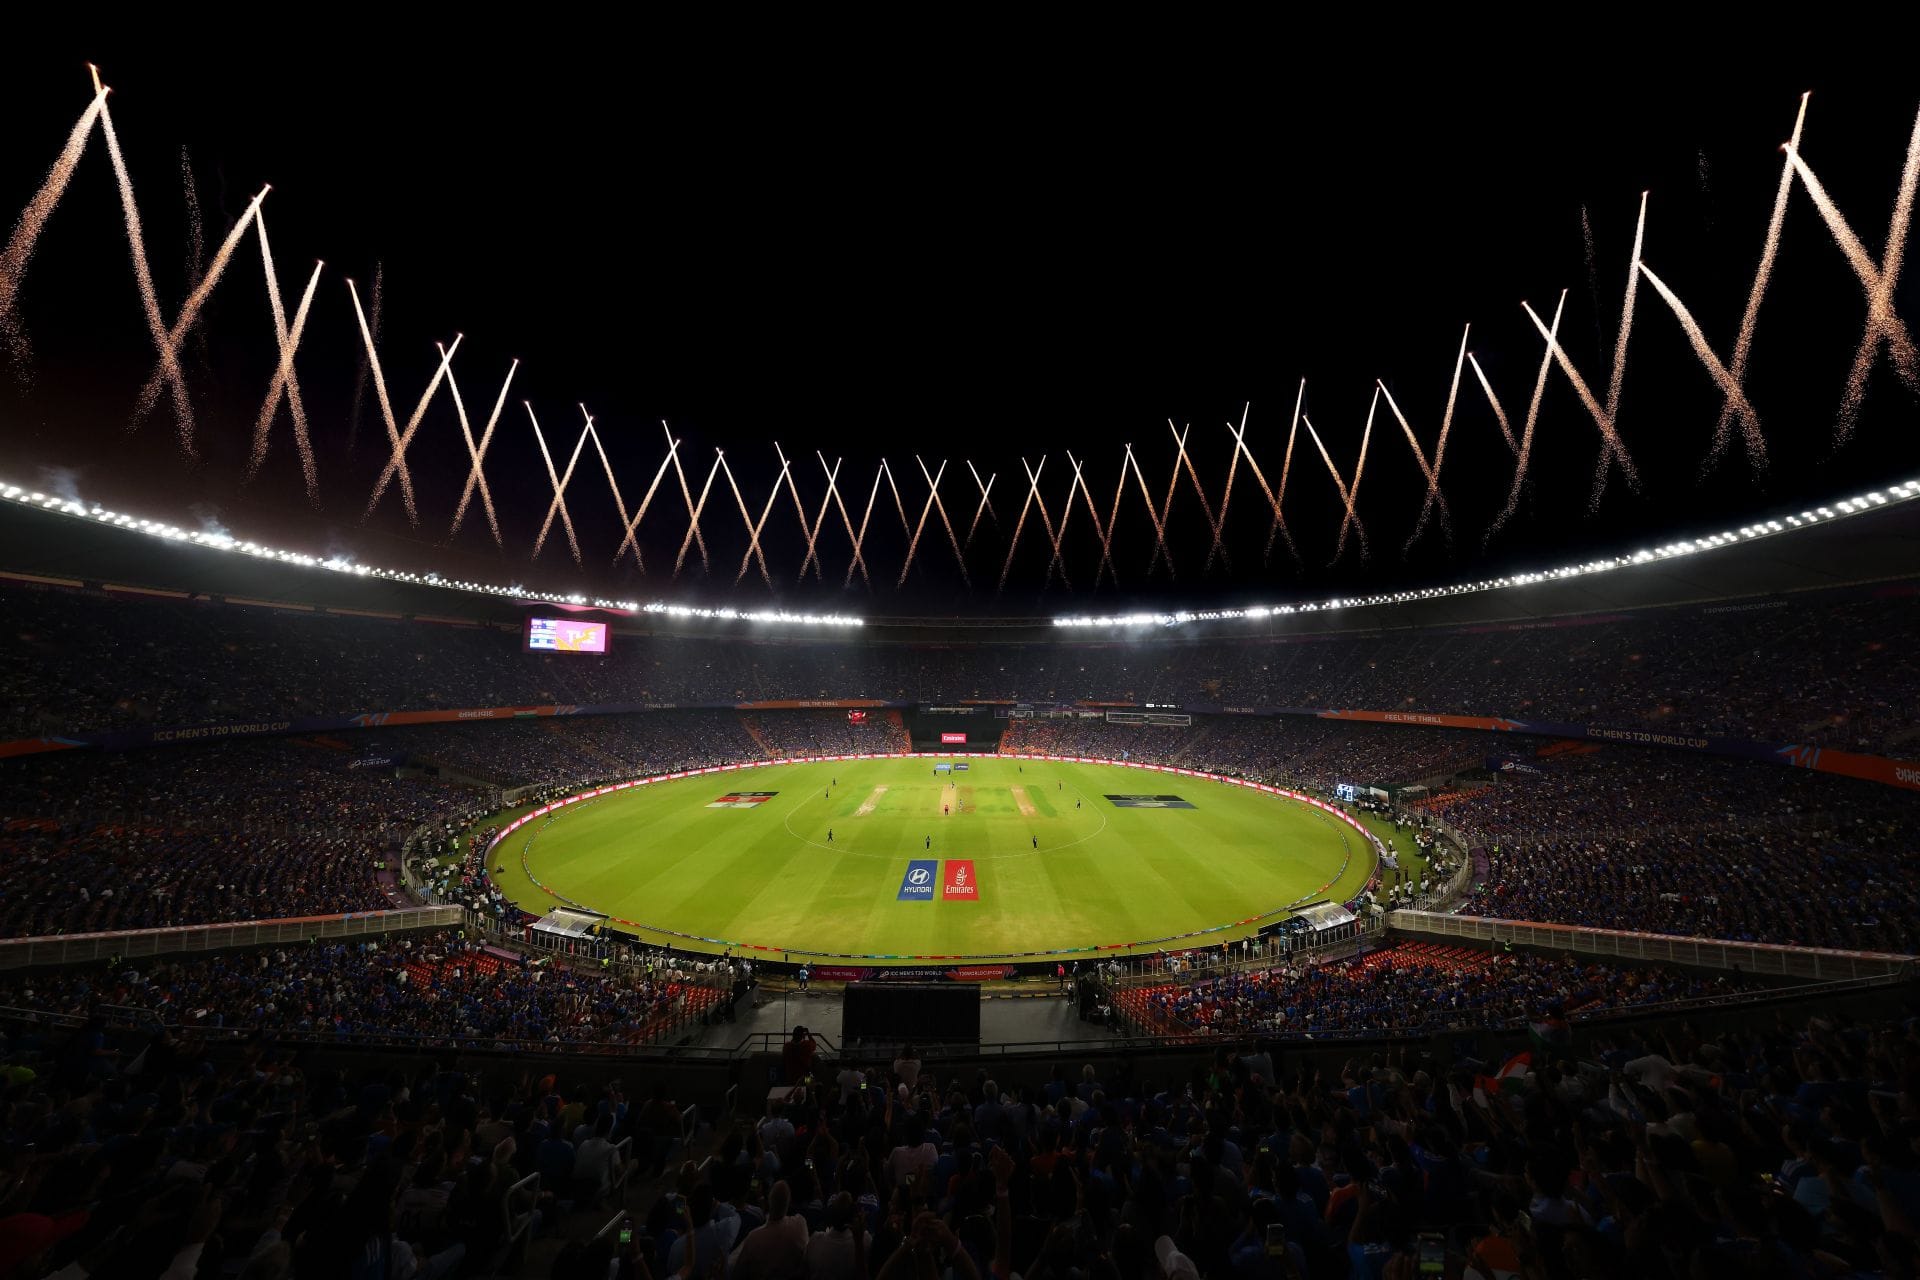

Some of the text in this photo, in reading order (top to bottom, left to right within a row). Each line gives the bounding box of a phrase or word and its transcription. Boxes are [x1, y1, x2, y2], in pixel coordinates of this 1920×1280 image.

[1418, 715, 1442, 724] THRILL
[153, 721, 291, 742] ICC MEN'S T20 WORLD CUP
[1586, 728, 1709, 749] ICC MEN'S T20 WORLD CUP
[904, 886, 932, 894] HYUNDAI
[945, 885, 974, 894] Emirates
